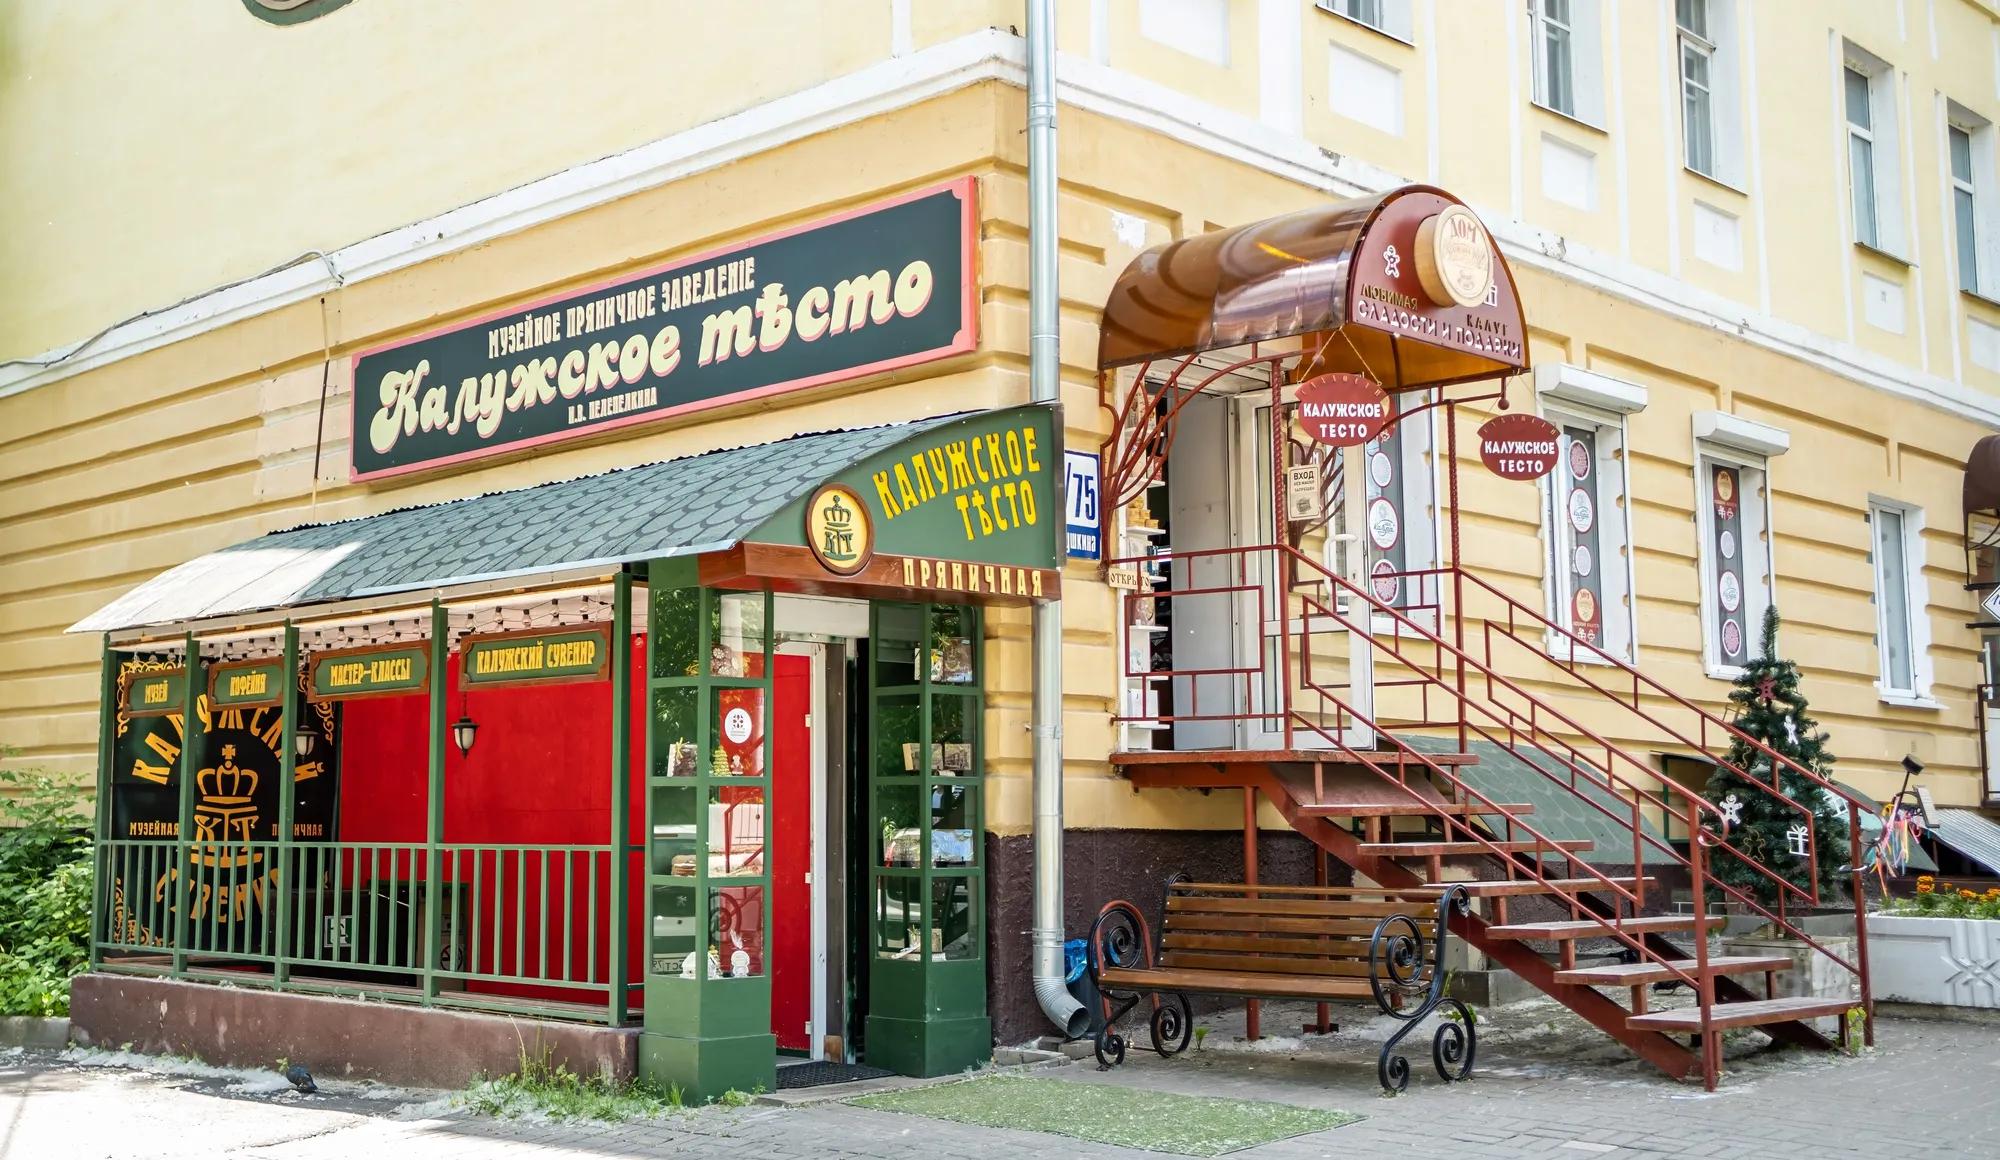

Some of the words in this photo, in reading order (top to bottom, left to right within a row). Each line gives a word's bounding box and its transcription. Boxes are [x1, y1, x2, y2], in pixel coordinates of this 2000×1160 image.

[1360, 282, 1418, 310] ЛЮБИМАЯ
[488, 312, 561, 359] МУЗЕЙНОЕ
[566, 285, 656, 338] ПРЯНИЧНОЕ
[1357, 300, 1438, 337] СЛАДОСТИ
[1442, 321, 1452, 342] И
[1456, 327, 1522, 360] ПОДАРКИ
[369, 325, 681, 454] Калужское
[1303, 402, 1381, 418] КАЛУЖСКОЕ
[1319, 423, 1368, 438] ТЕСТО
[1484, 440, 1556, 455] КАЛУЖСКОЕ
[872, 427, 1041, 520] КАЛУЖСКОЕ
[1293, 470, 1314, 480] ВХОД
[1499, 459, 1544, 473] ТЕСТО
[902, 557, 1043, 597] ПРЯНИЧНАЯ
[476, 640, 544, 674] КАЛУЖСКИЙ
[546, 640, 596, 669] СУВЕНИР
[330, 658, 411, 687] МАСТЕР-КЛАССЫ
[144, 680, 168, 704] МУЗЕЙ
[129, 820, 179, 836] МУЗЕЙНАЯ
[272, 823, 323, 836] ПИЧНАЯ
